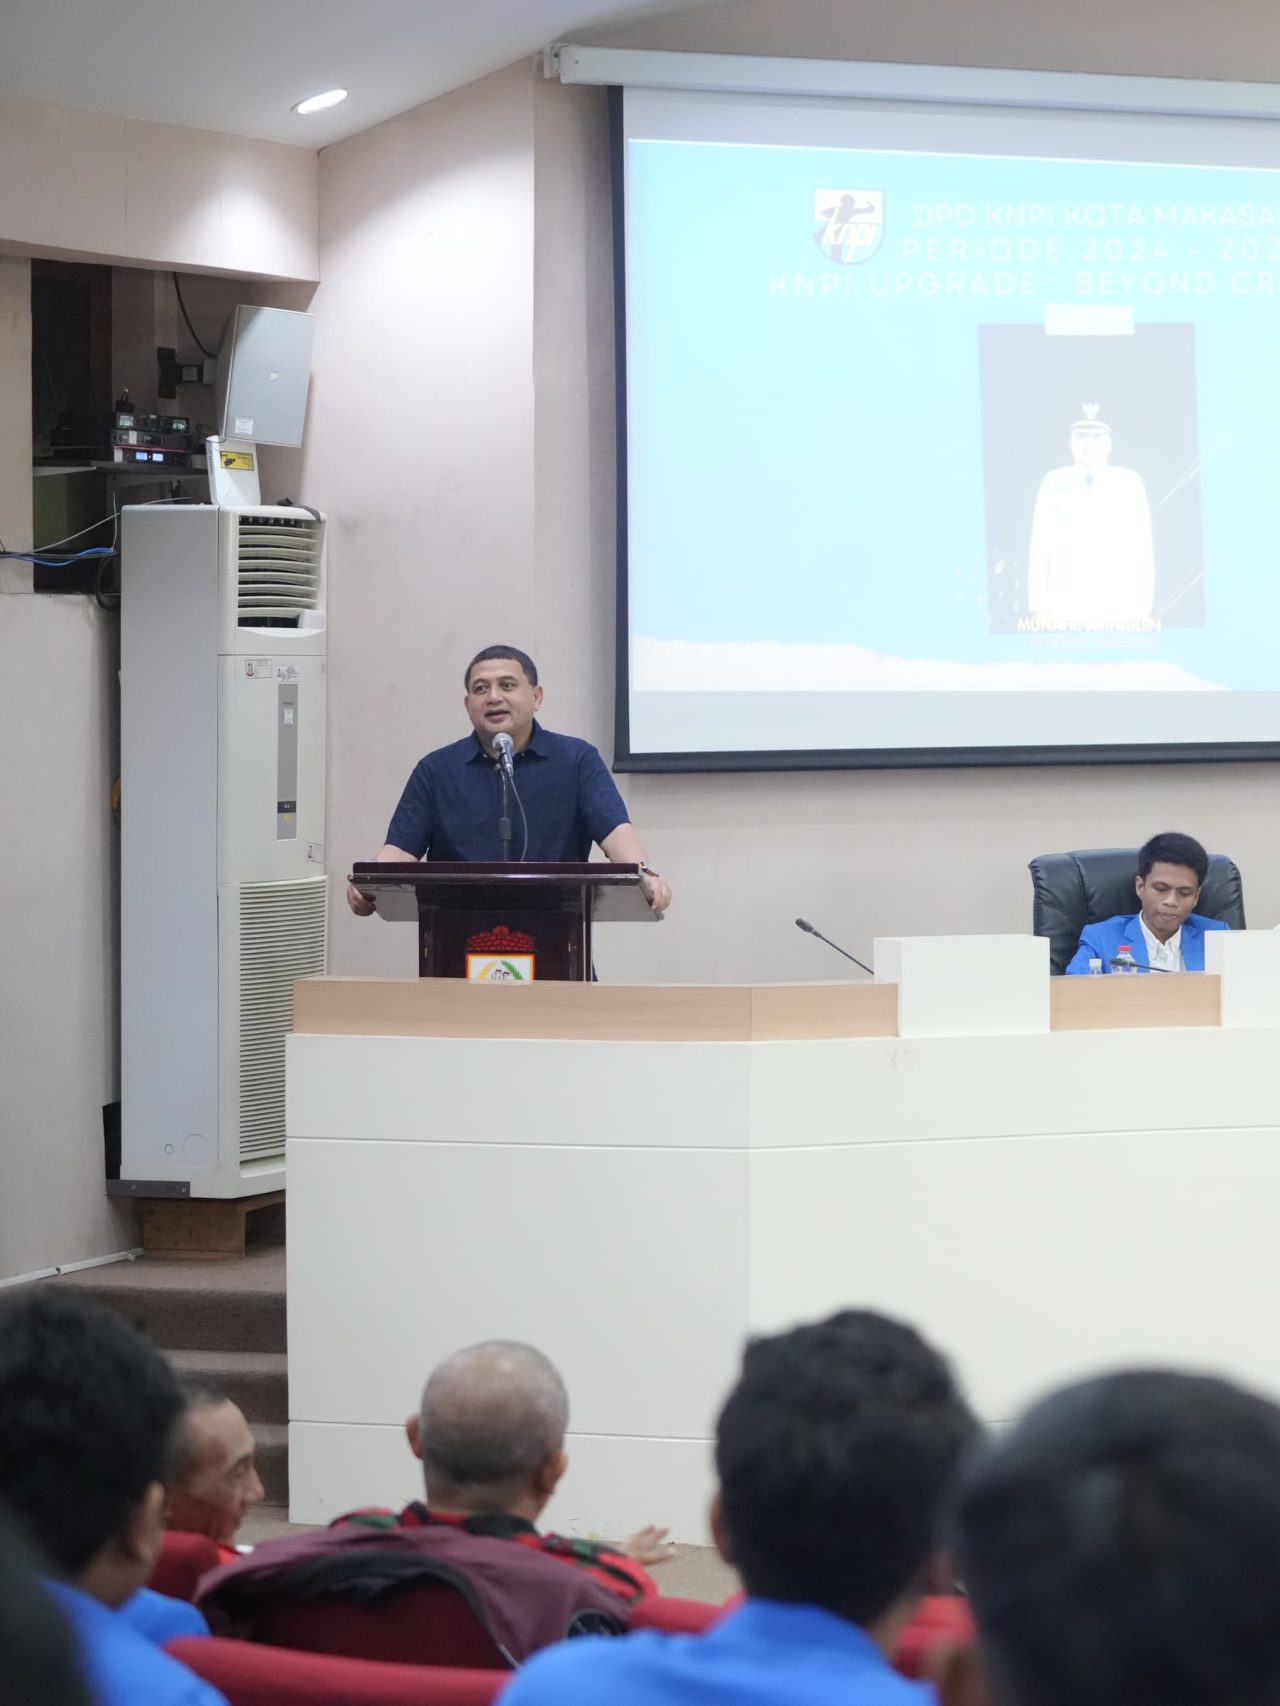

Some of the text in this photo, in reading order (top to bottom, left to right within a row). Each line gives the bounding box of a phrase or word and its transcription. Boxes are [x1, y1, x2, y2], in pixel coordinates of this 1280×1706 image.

[912, 203, 975, 227] DPD
[986, 203, 1054, 227] KNPI
[1063, 203, 1146, 227] KOTA
[902, 238, 1063, 262] PERIODE
[1082, 238, 1169, 262] 2024
[768, 271, 850, 297] KNPI
[868, 271, 1038, 296] UPGRADE
[1075, 271, 1216, 295] BEYOND
